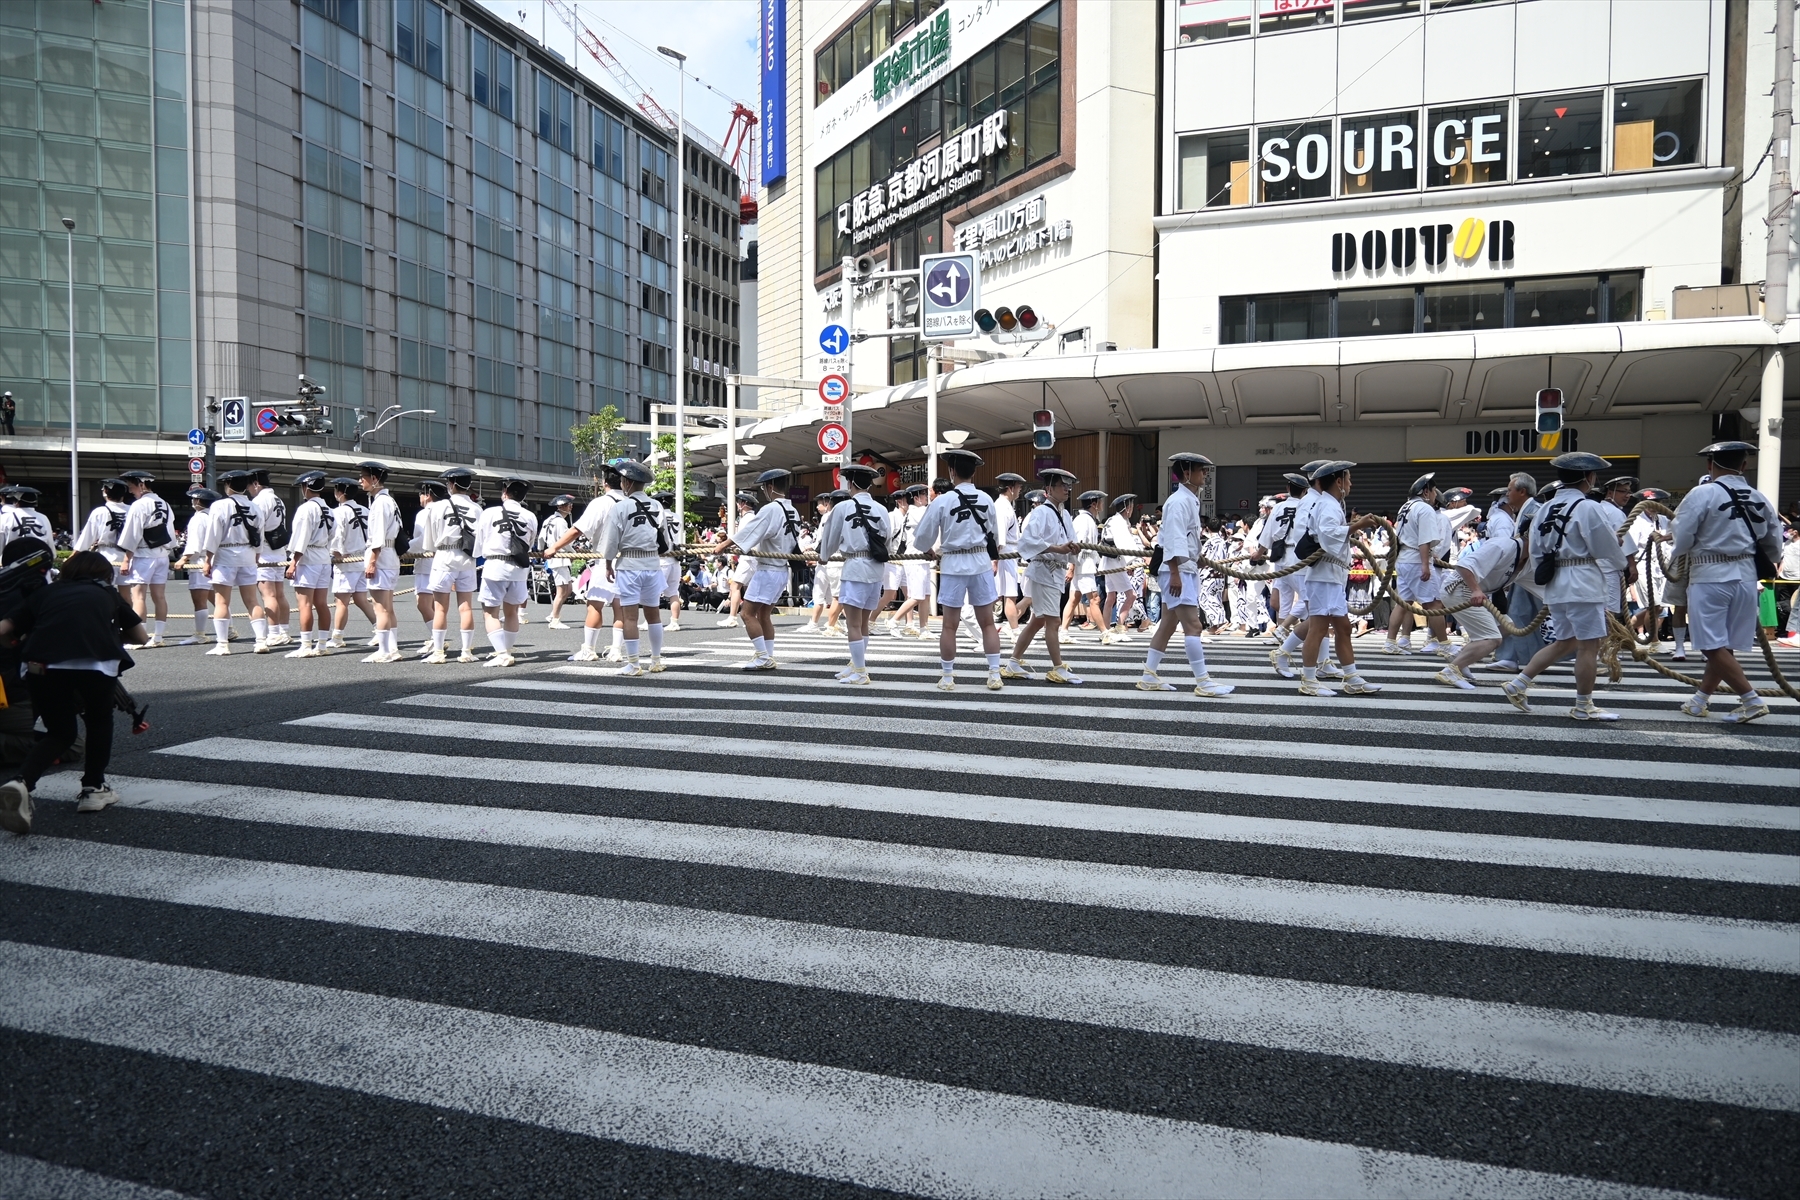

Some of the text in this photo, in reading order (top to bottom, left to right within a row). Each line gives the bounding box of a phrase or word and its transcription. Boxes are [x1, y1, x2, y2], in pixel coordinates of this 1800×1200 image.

[874, 8, 950, 101] 眼鏡市場
[766, 99, 774, 169] みずほ銀行
[1261, 114, 1502, 182] SOURCE
[853, 220, 879, 245] Hankyu
[948, 169, 982, 194] Station
[1332, 217, 1514, 272] DOUTOR
[926, 315, 971, 328] 路線バスを除く
[1465, 428, 1578, 455] DOUTOR
[845, 503, 881, 534] 長
[950, 494, 989, 524] 長
[1718, 488, 1766, 523] 長
[12, 516, 46, 537] 長
